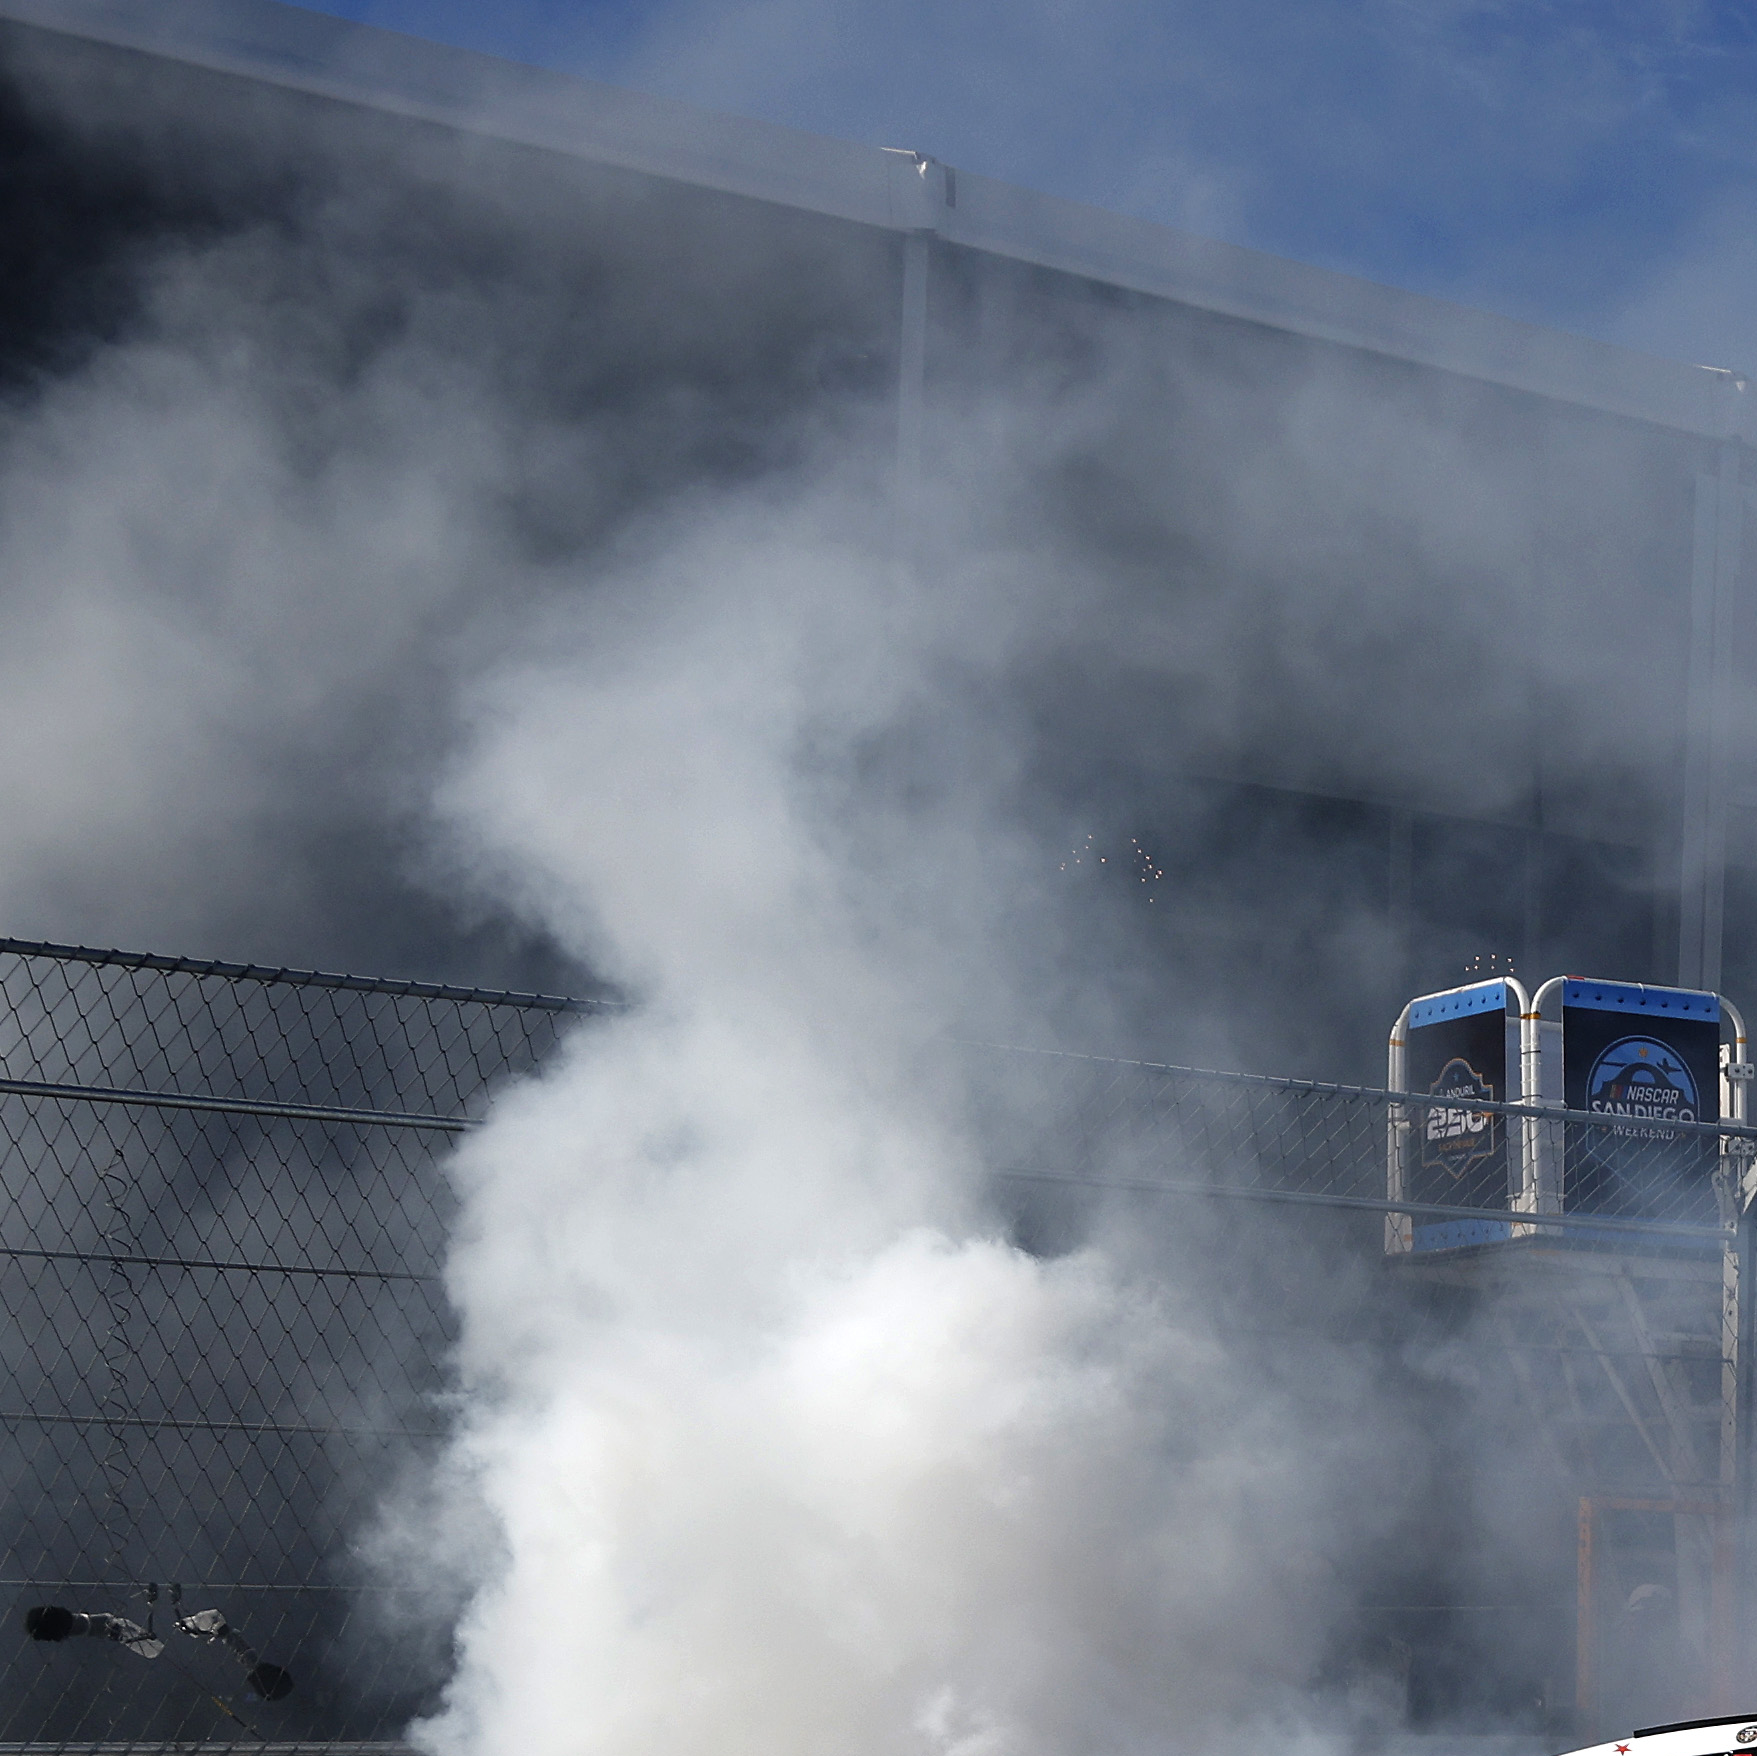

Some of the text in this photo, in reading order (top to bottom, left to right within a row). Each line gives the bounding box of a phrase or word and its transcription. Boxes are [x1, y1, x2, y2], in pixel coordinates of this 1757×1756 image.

[1627, 1085, 1679, 1104] NASCAR
[1592, 1100, 1695, 1122] SAN DIEGO
[1613, 1124, 1674, 1140] WEEKEND
